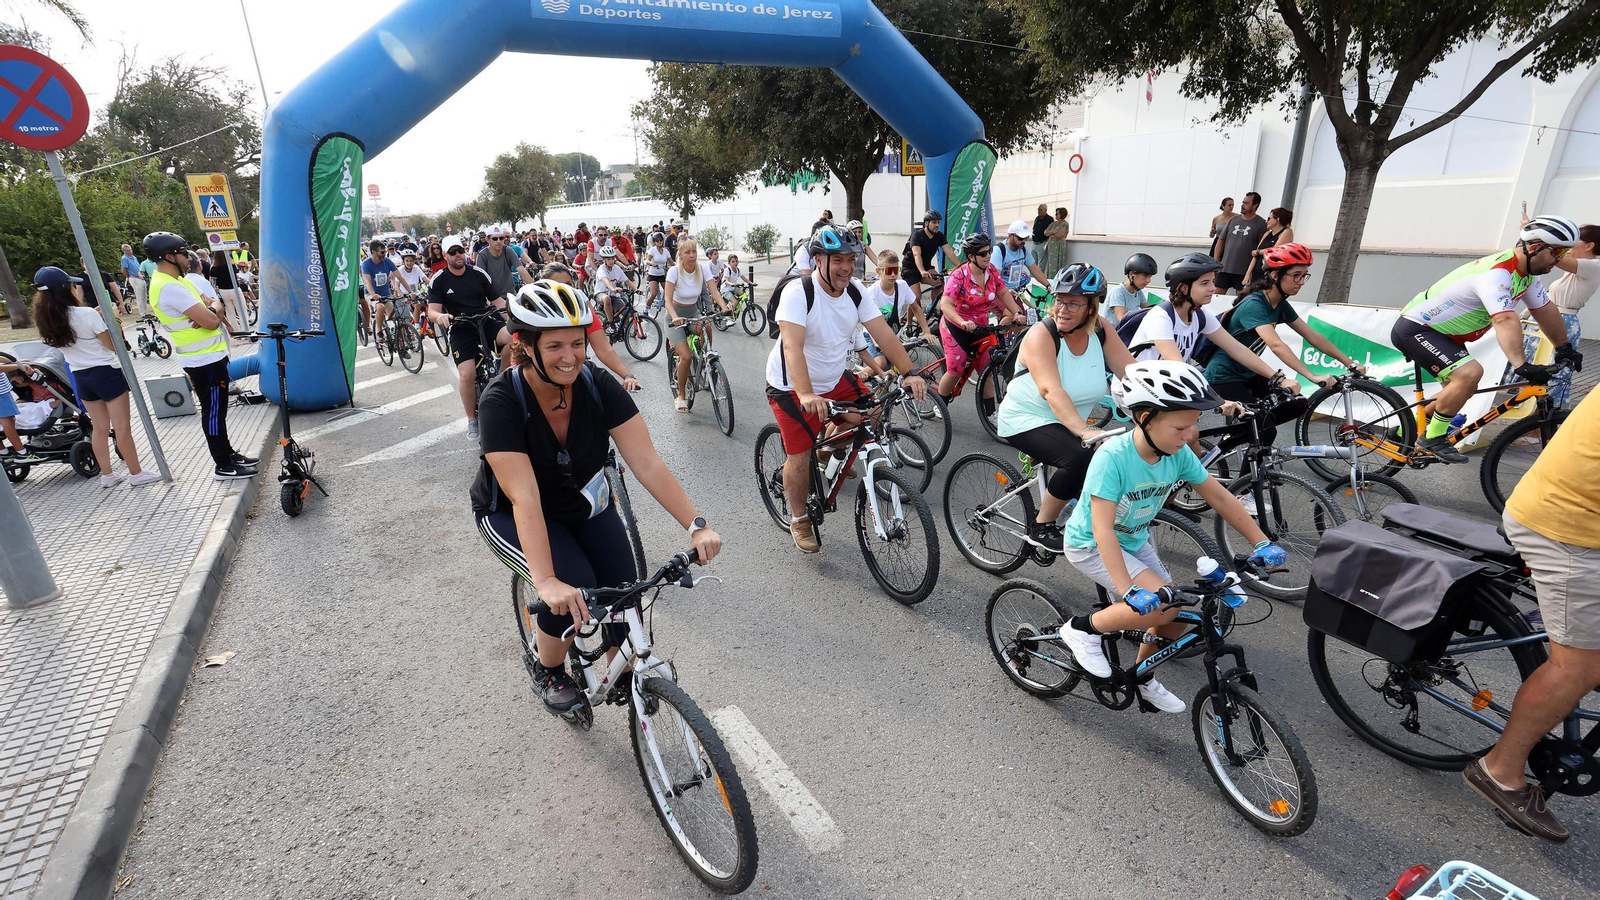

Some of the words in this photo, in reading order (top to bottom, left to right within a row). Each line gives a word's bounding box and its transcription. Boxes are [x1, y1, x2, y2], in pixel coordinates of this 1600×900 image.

[579, 4, 662, 20] Deportes
[594, 0, 748, 13] ntamiento
[752, 4, 778, 15] de
[783, 5, 834, 19] Jerez
[904, 165, 924, 173] PEATONES
[203, 219, 234, 228] PEATONES
[1303, 347, 1320, 366] El
[1145, 642, 1179, 667] NEON
